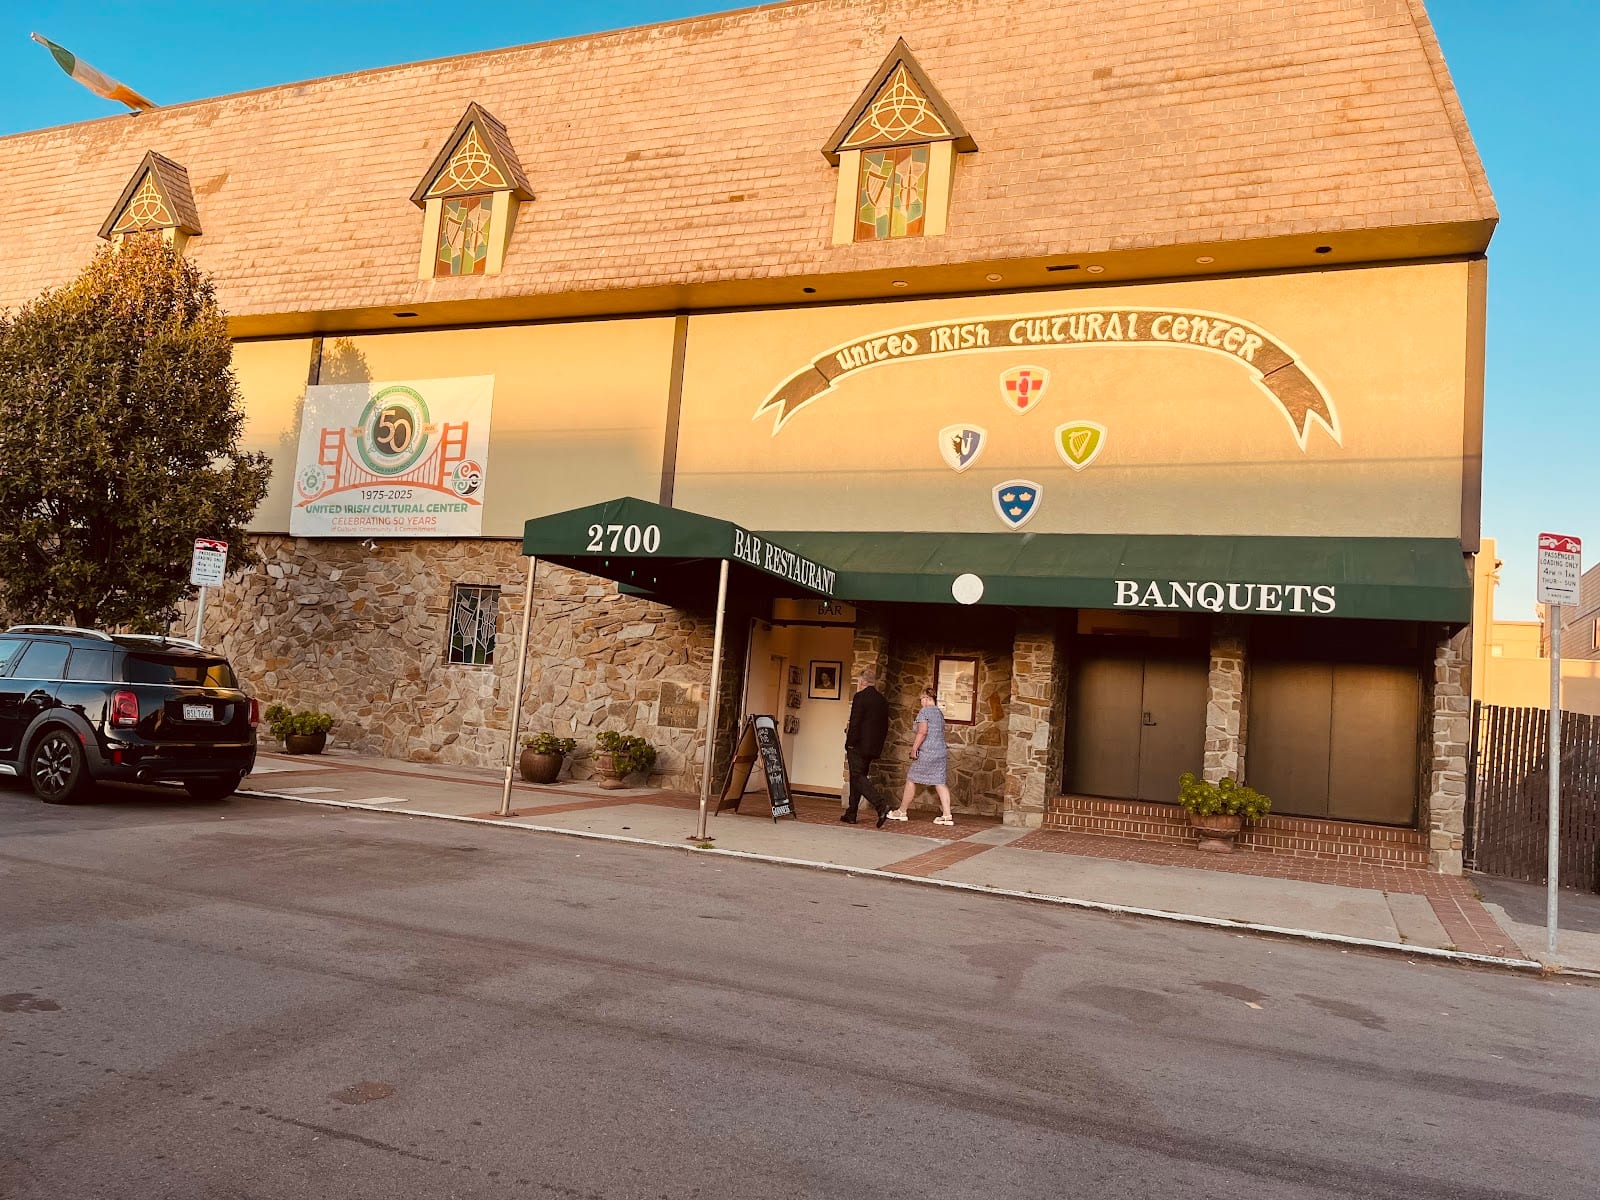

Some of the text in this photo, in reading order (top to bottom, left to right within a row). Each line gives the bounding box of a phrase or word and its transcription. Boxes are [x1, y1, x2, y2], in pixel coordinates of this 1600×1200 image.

[377, 409, 412, 453] 50
[362, 489, 413, 500] 1975-2025
[306, 503, 468, 514] UNITED IRISH CULTURAL CENTER
[332, 517, 437, 525] CELEBRATING 50 YEARS
[586, 524, 661, 553] 2700
[1544, 551, 1575, 561] PASSENGER
[733, 528, 836, 596] BAR RESTAURANT
[1540, 559, 1579, 569] LOADING ONLY
[1113, 580, 1336, 614] BANQUETS
[818, 605, 842, 616] BAR
